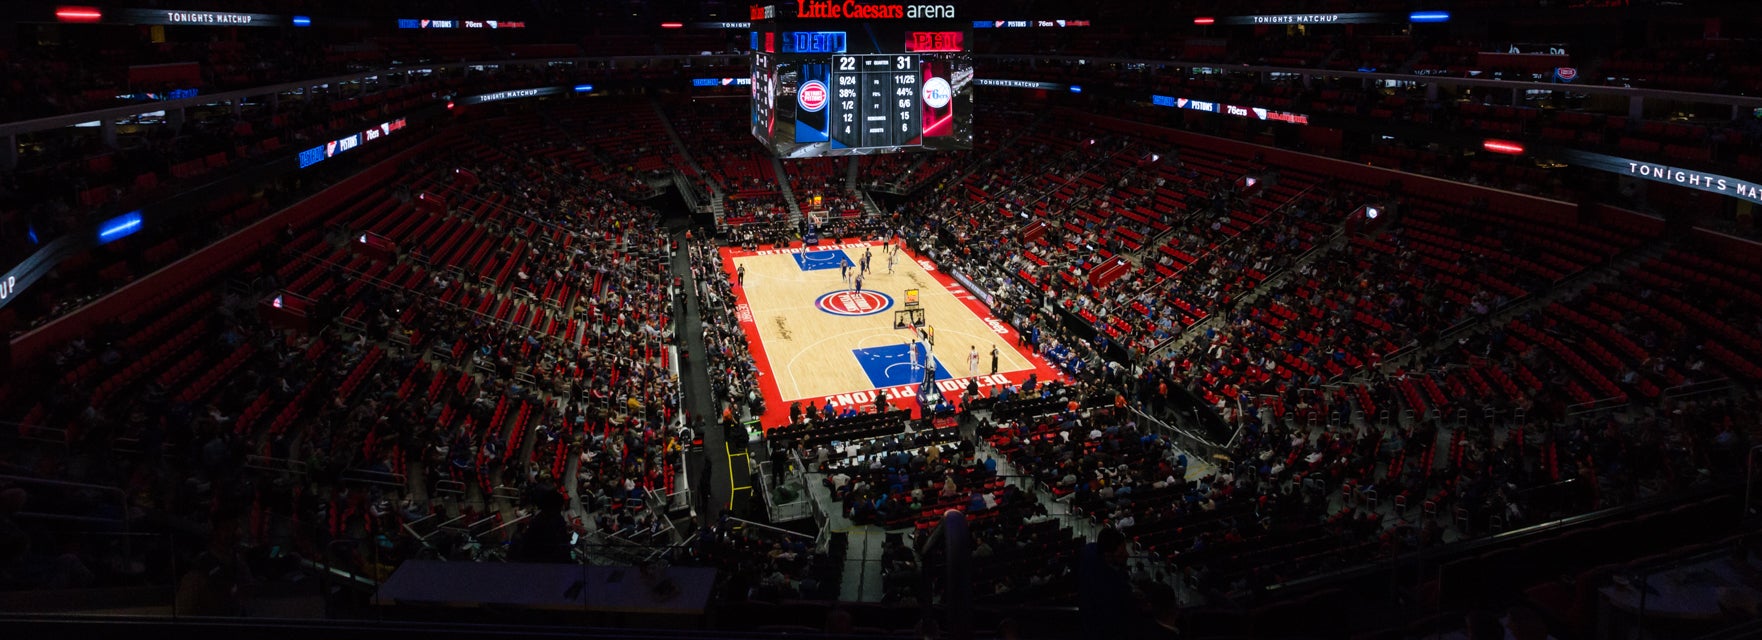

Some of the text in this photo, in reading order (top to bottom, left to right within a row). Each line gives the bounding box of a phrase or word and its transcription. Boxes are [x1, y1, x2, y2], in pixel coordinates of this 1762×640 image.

[797, 0, 841, 18] Little
[842, 0, 904, 19] Caesars
[906, 4, 955, 18] arena
[168, 12, 252, 24] TONIGHTS MATCHUP
[1297, 15, 1338, 23] MATCHUP
[432, 20, 483, 28] PISTONS 76ers
[912, 32, 959, 51] PHI
[840, 57, 855, 70] 22
[897, 56, 911, 70] 31
[839, 76, 856, 85] 9/24
[894, 75, 915, 84] 11/25
[480, 89, 538, 102] TONIGHTS MATCHUP
[839, 89, 856, 98] 38%
[896, 87, 913, 96] 44%
[926, 88, 949, 99] 76ers
[841, 101, 855, 110] 1/2
[899, 99, 911, 108] 6/6
[1191, 100, 1248, 116] PISTONS 76ers
[843, 113, 853, 122] 12
[900, 111, 910, 120] 15
[845, 125, 851, 134] 4
[902, 123, 908, 132] 6
[339, 134, 358, 152] PISTONS
[366, 128, 380, 141] 76ers
[1629, 163, 1727, 191] TONIGHTS
[816, 242, 872, 251] PISTONS
[917, 260, 935, 271] Jeep
[0, 275, 15, 300] UP
[984, 317, 1009, 334] Jeep
